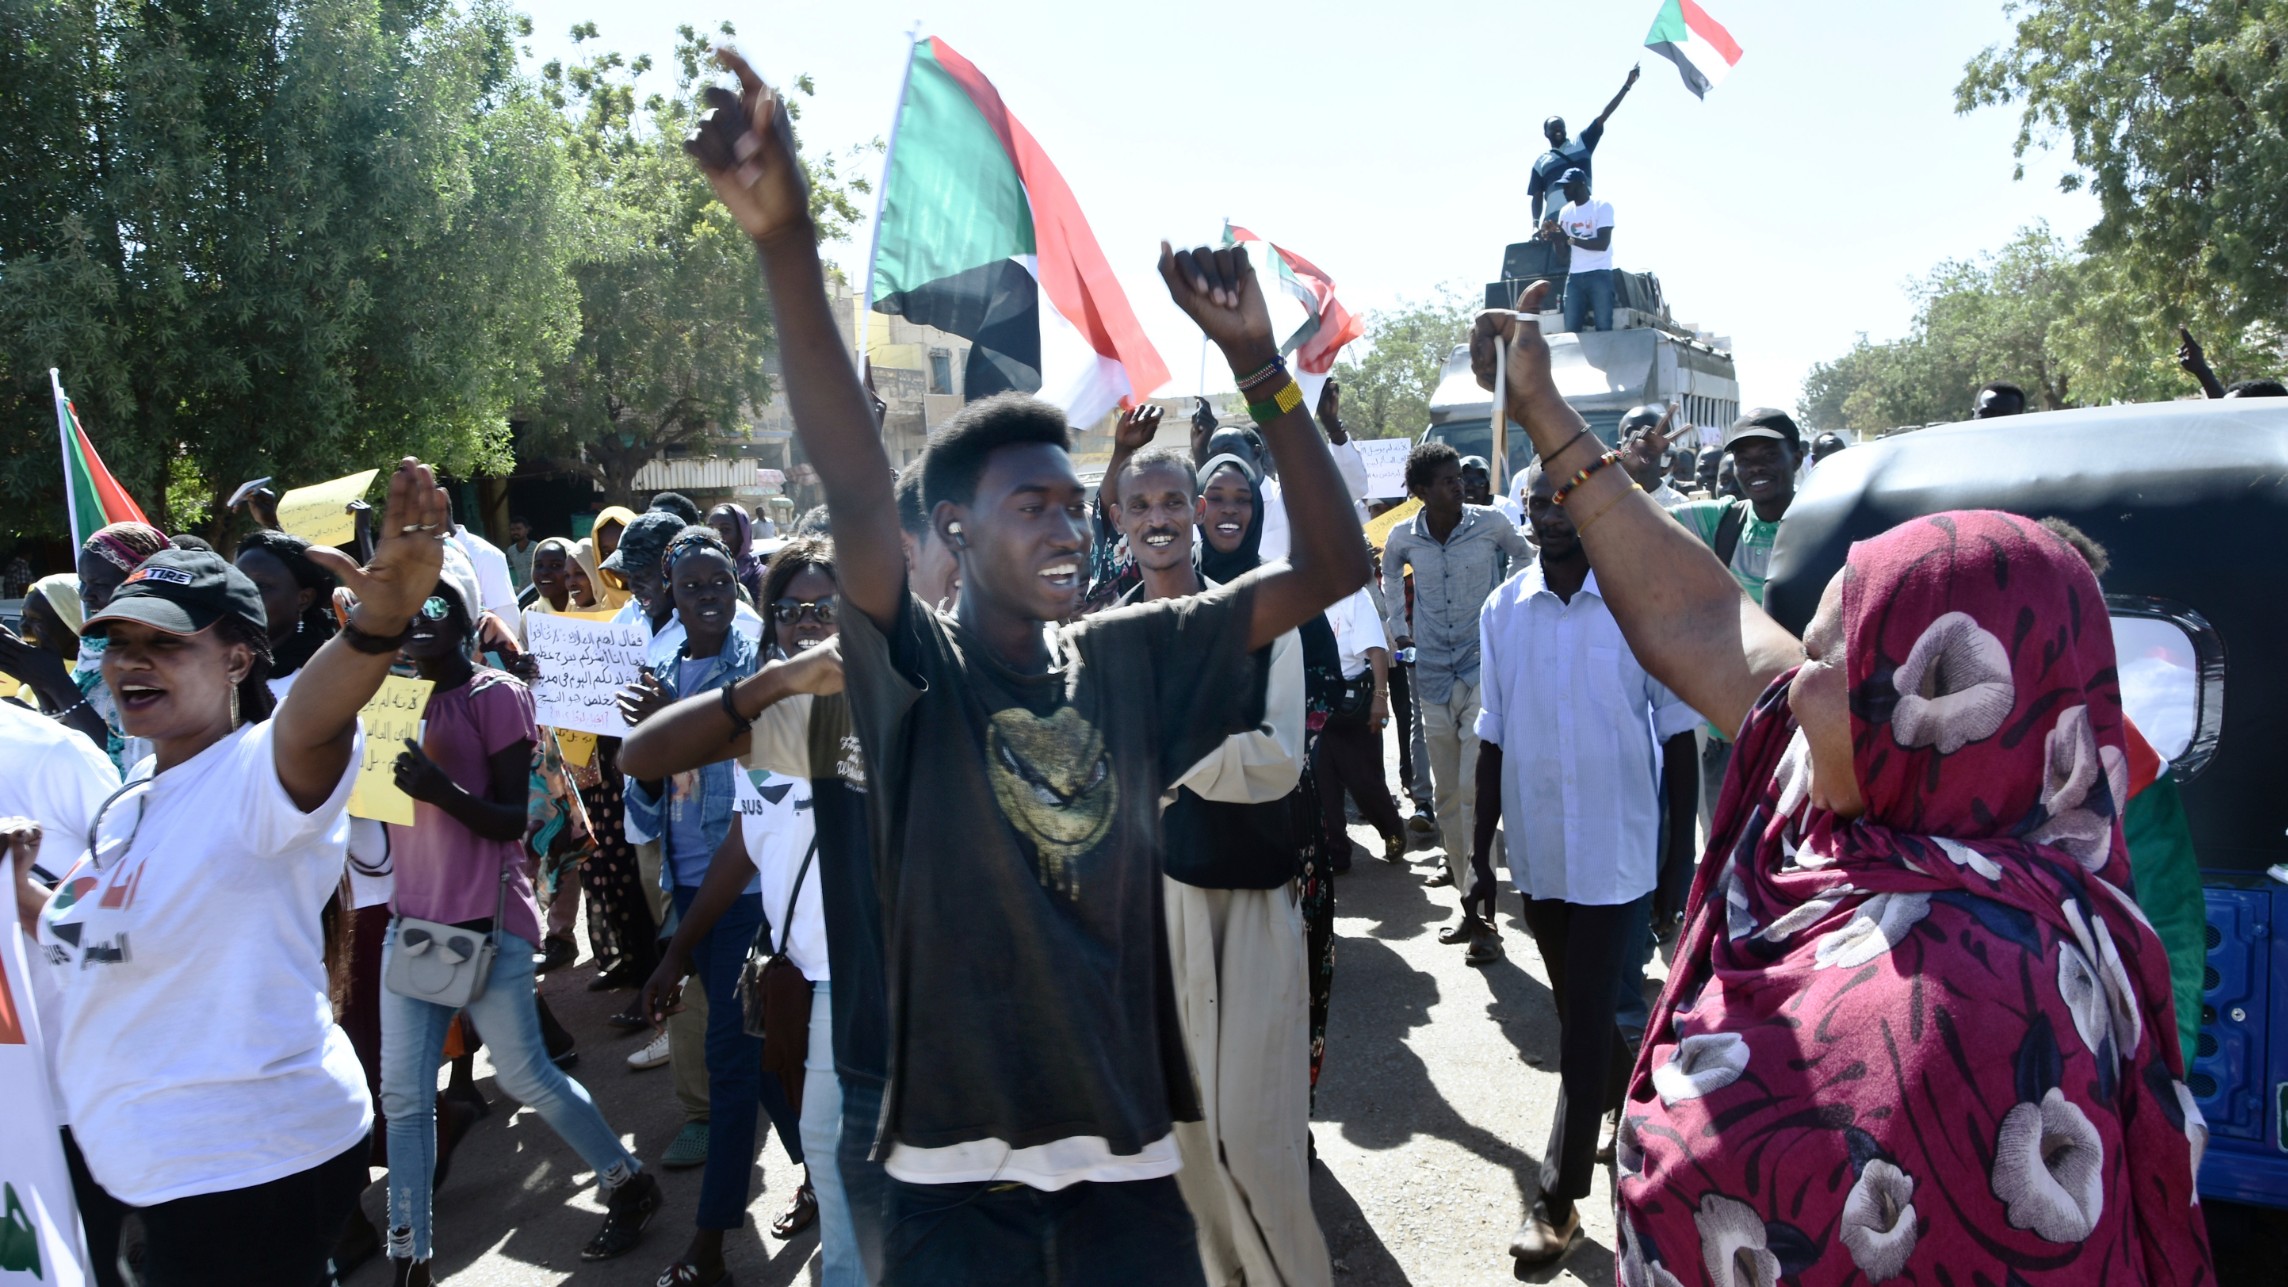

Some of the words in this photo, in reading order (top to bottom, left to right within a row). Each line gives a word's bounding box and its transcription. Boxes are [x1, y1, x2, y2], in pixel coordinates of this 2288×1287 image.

[149, 568, 189, 583] TIRE
[597, 629, 615, 649] لهم
[618, 628, 644, 647] فقال
